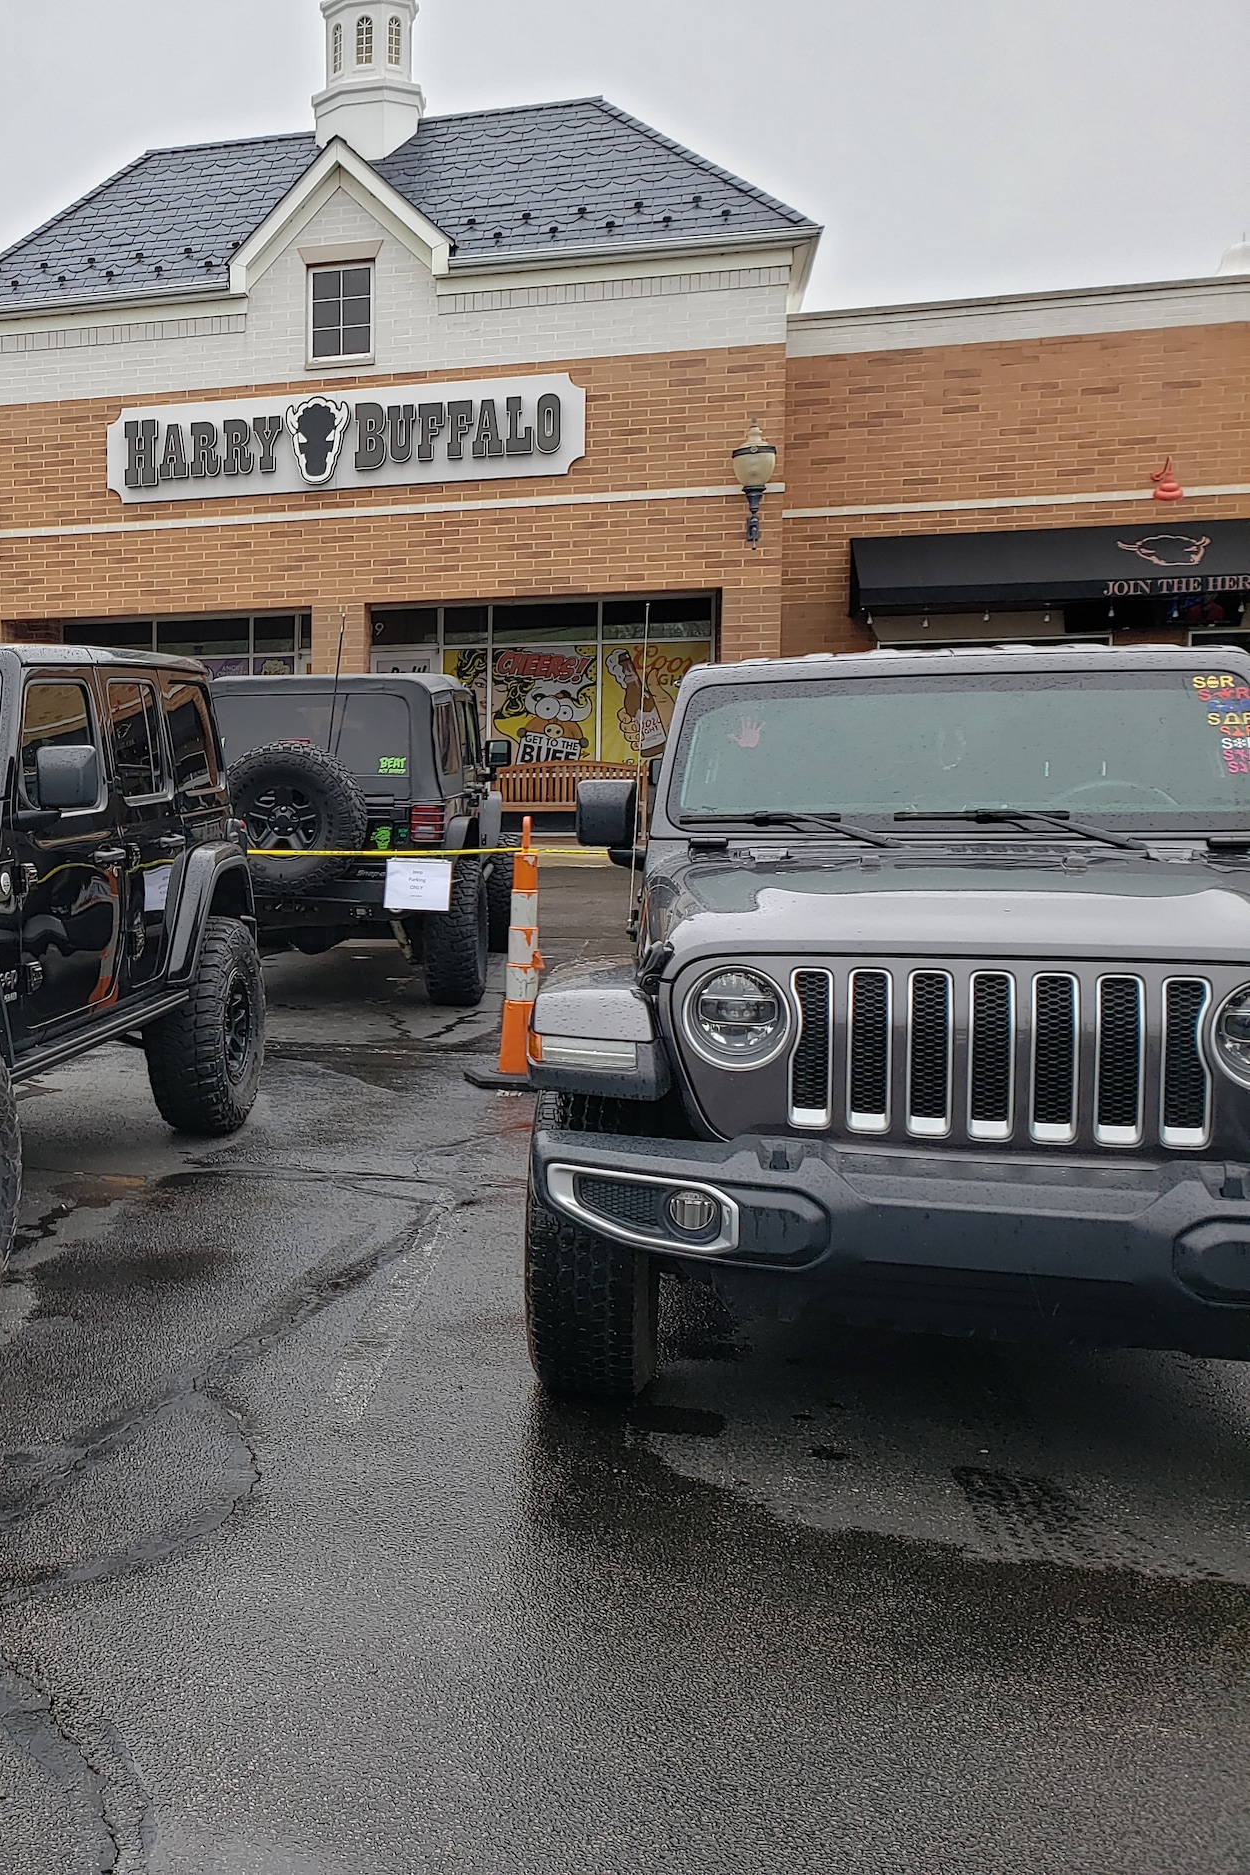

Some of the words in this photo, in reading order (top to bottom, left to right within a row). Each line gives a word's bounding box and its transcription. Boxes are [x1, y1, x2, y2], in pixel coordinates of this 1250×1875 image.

[124, 418, 283, 488] HARRY
[354, 392, 562, 471] BUFFALO
[1103, 580, 1152, 596] JOIN
[1158, 577, 1202, 594] THE
[1207, 574, 1250, 591] HER
[497, 651, 592, 684] CHEERS!
[525, 734, 543, 745] GET
[545, 737, 559, 747] TO
[561, 740, 579, 751] THE
[379, 757, 407, 769] BEAT
